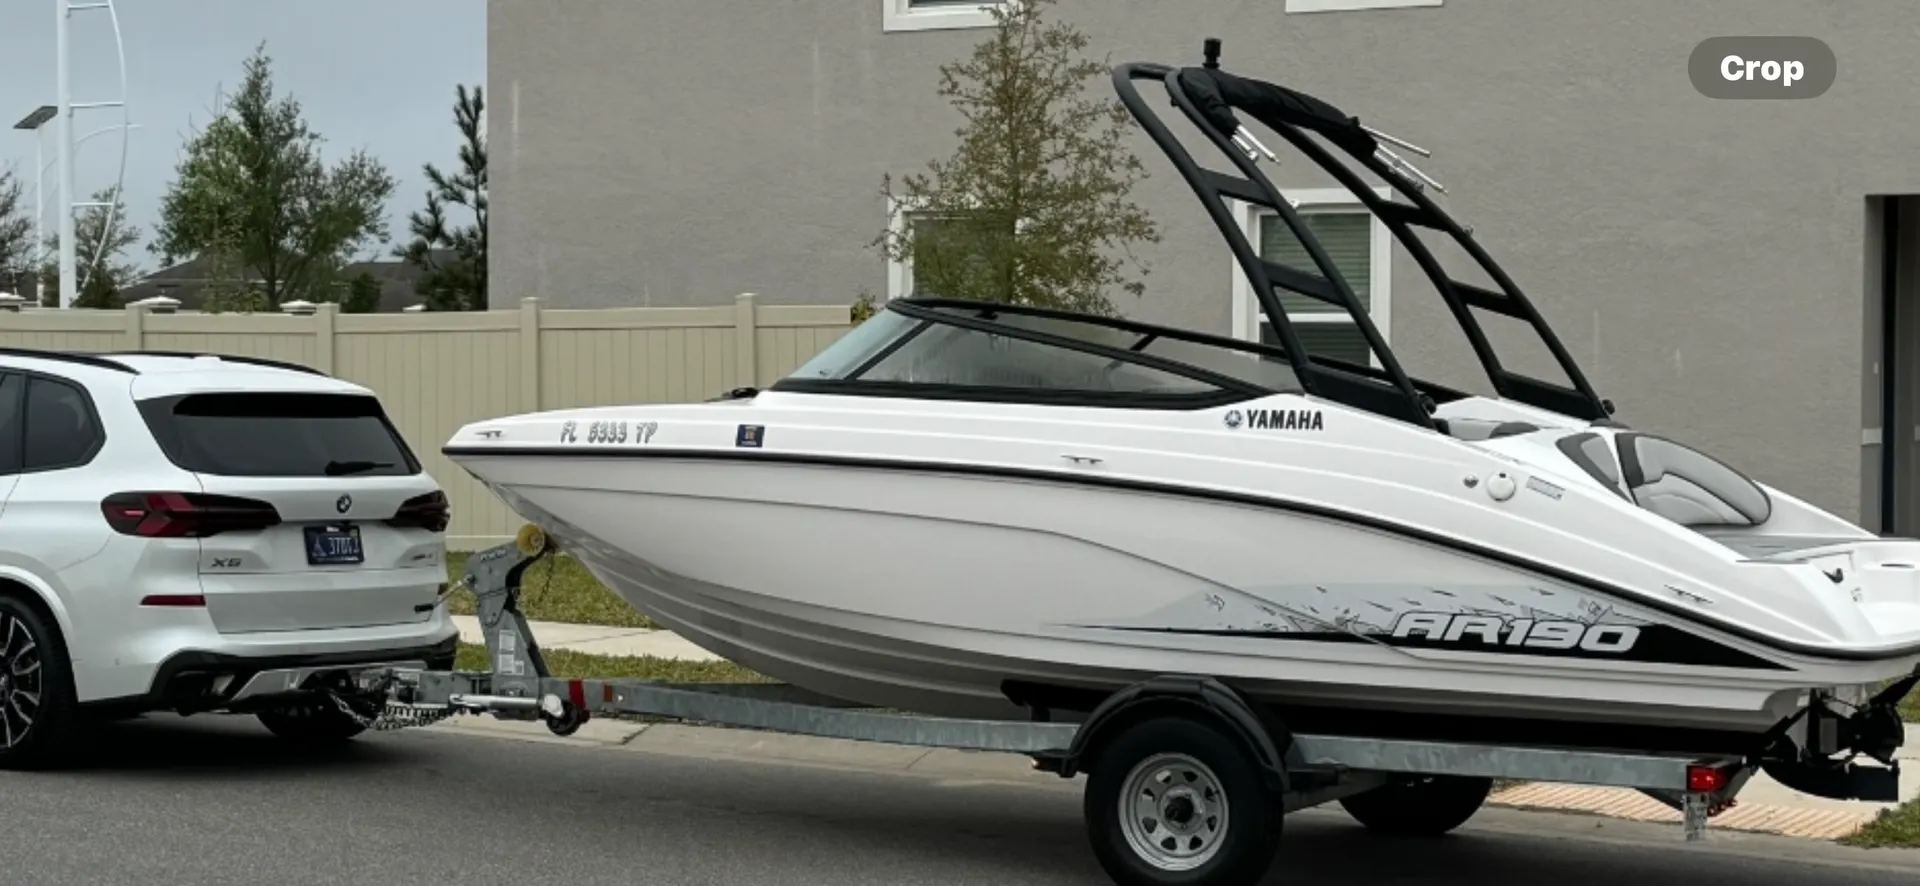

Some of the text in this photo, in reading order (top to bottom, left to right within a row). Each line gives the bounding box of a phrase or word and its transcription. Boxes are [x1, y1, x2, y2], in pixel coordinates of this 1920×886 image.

[560, 420, 577, 443] FL
[636, 421, 658, 443] TP
[1246, 409, 1324, 431] YAMAHA
[1392, 612, 1641, 653] AR190
